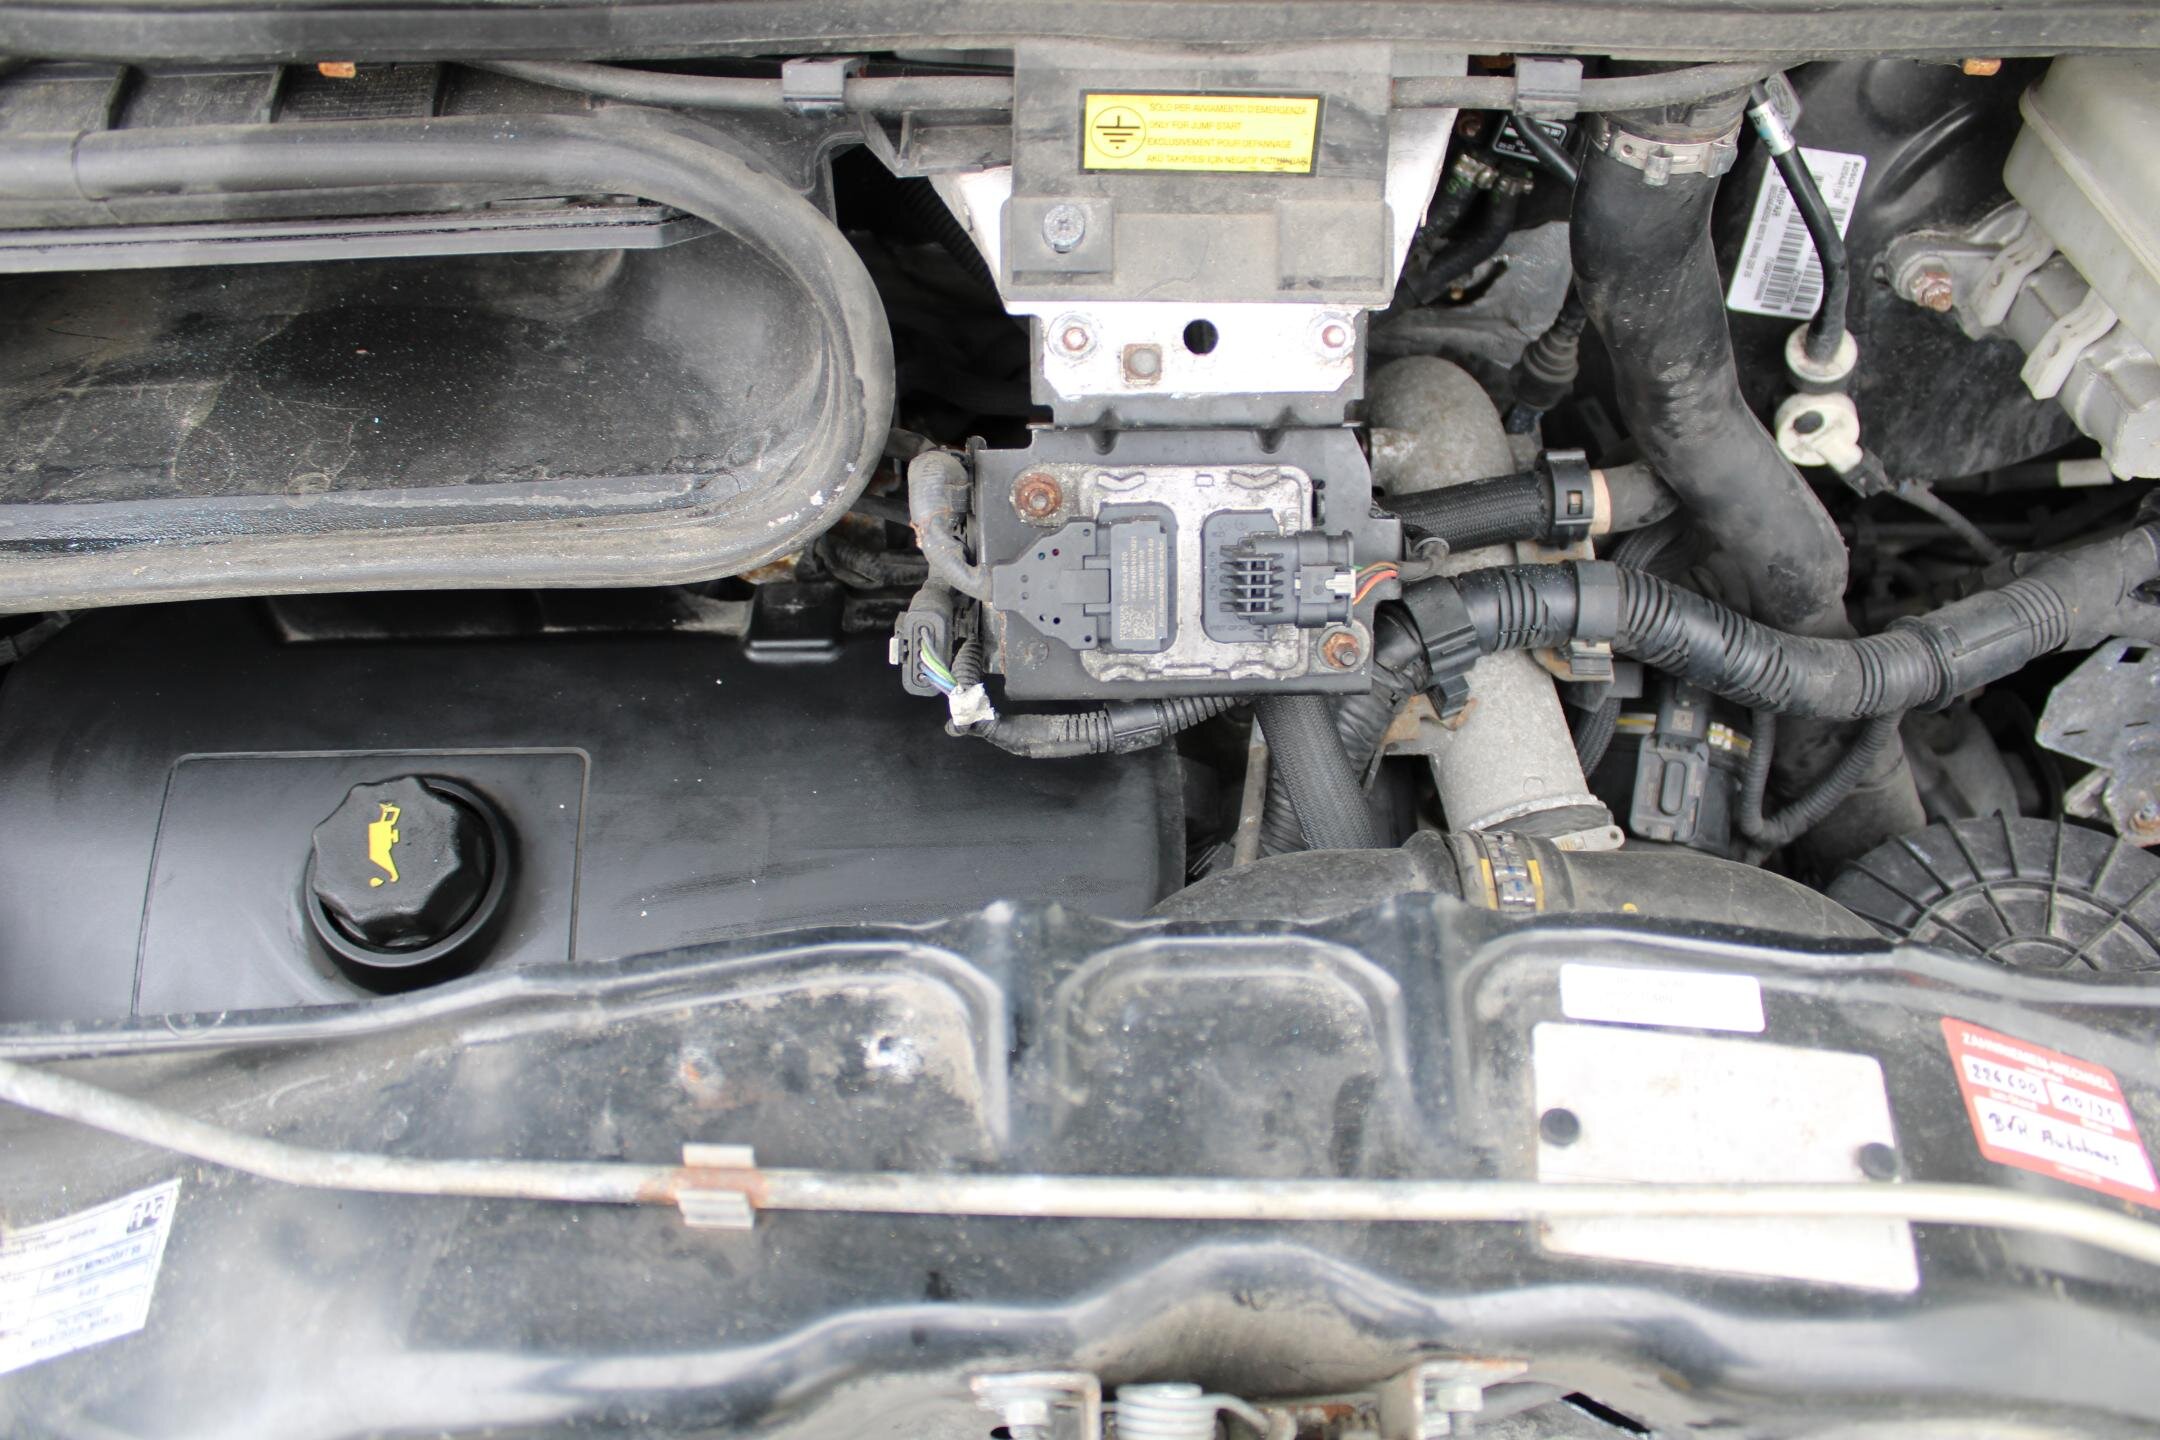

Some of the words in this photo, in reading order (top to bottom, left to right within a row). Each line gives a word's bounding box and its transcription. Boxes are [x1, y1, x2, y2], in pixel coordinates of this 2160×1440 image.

[1149, 120, 1169, 129] ONLY
[1172, 121, 1189, 129] FOR
[1191, 121, 1212, 130] JUMP
[1216, 121, 1242, 131] START
